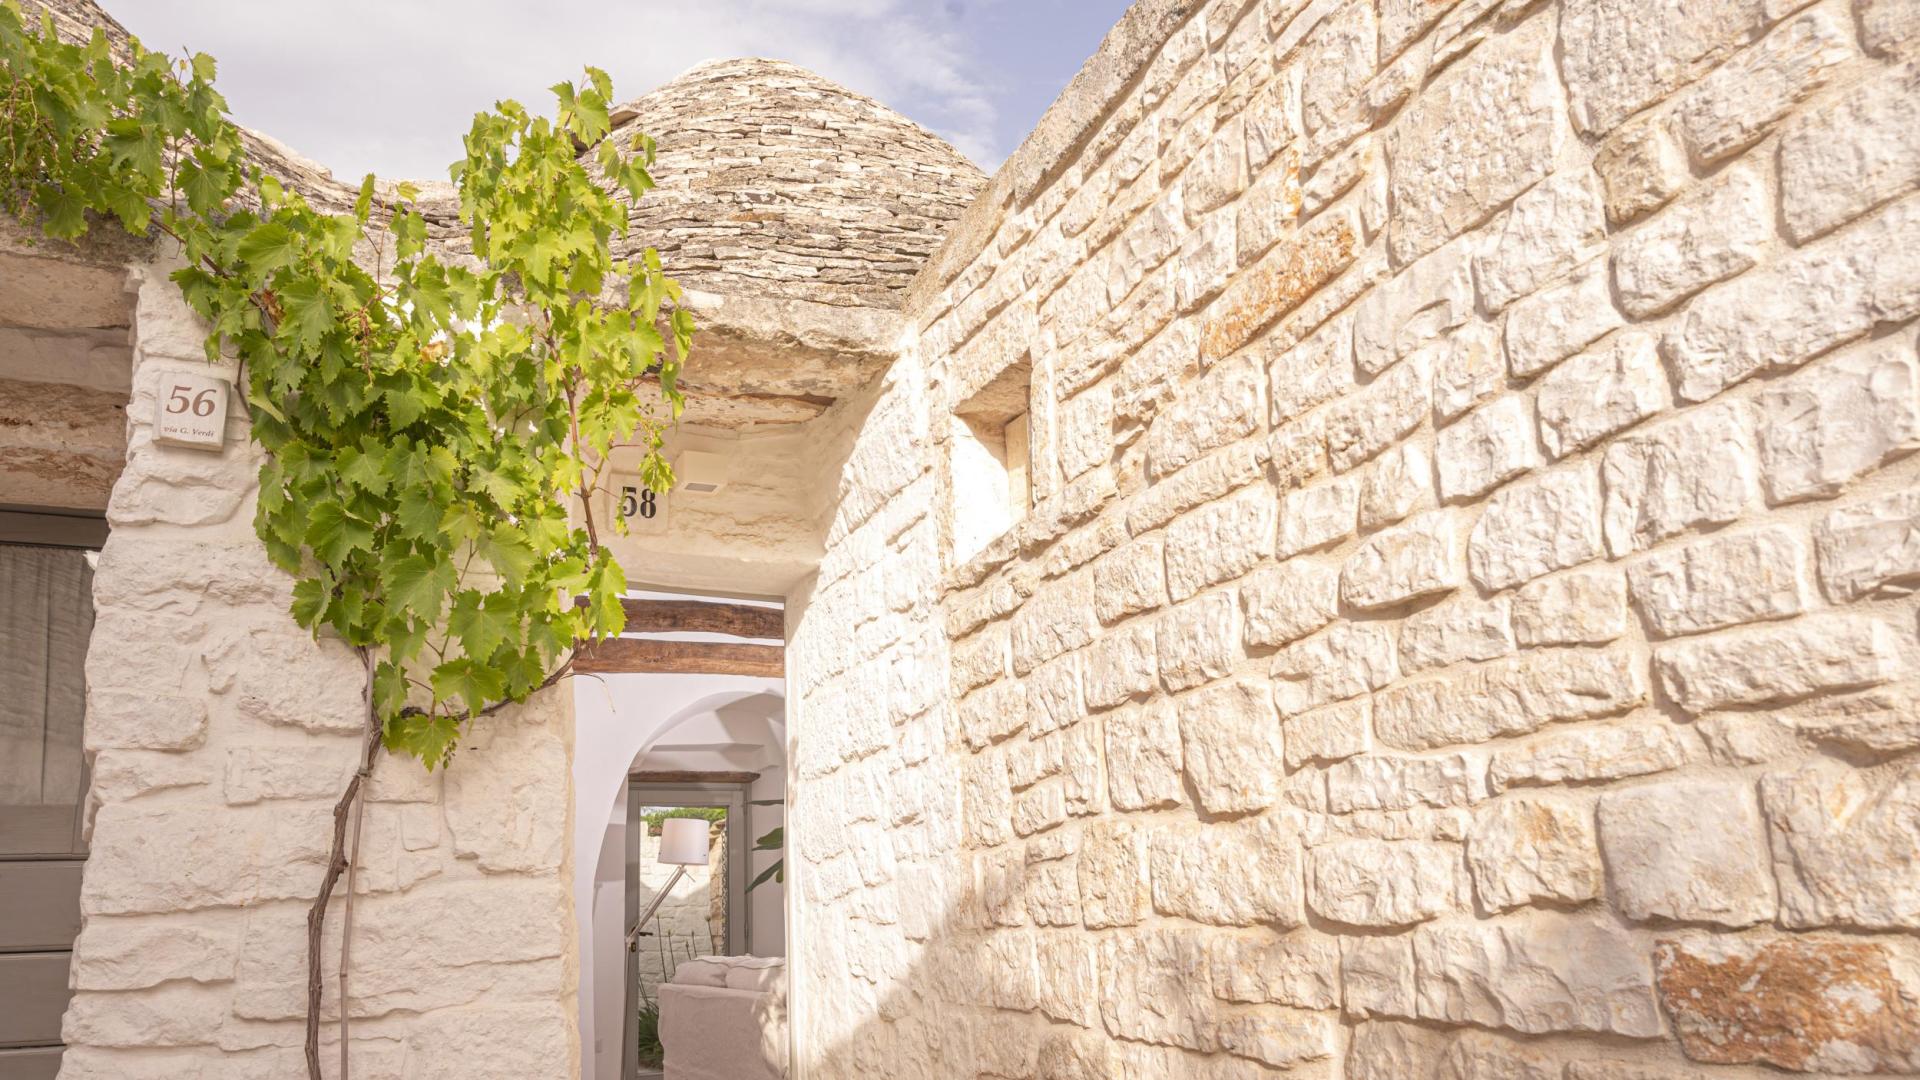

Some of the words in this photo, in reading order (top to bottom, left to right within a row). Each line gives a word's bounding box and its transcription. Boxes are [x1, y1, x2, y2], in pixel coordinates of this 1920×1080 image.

[166, 384, 217, 417] 56
[192, 428, 215, 437] Verdi
[622, 486, 657, 518] 58
